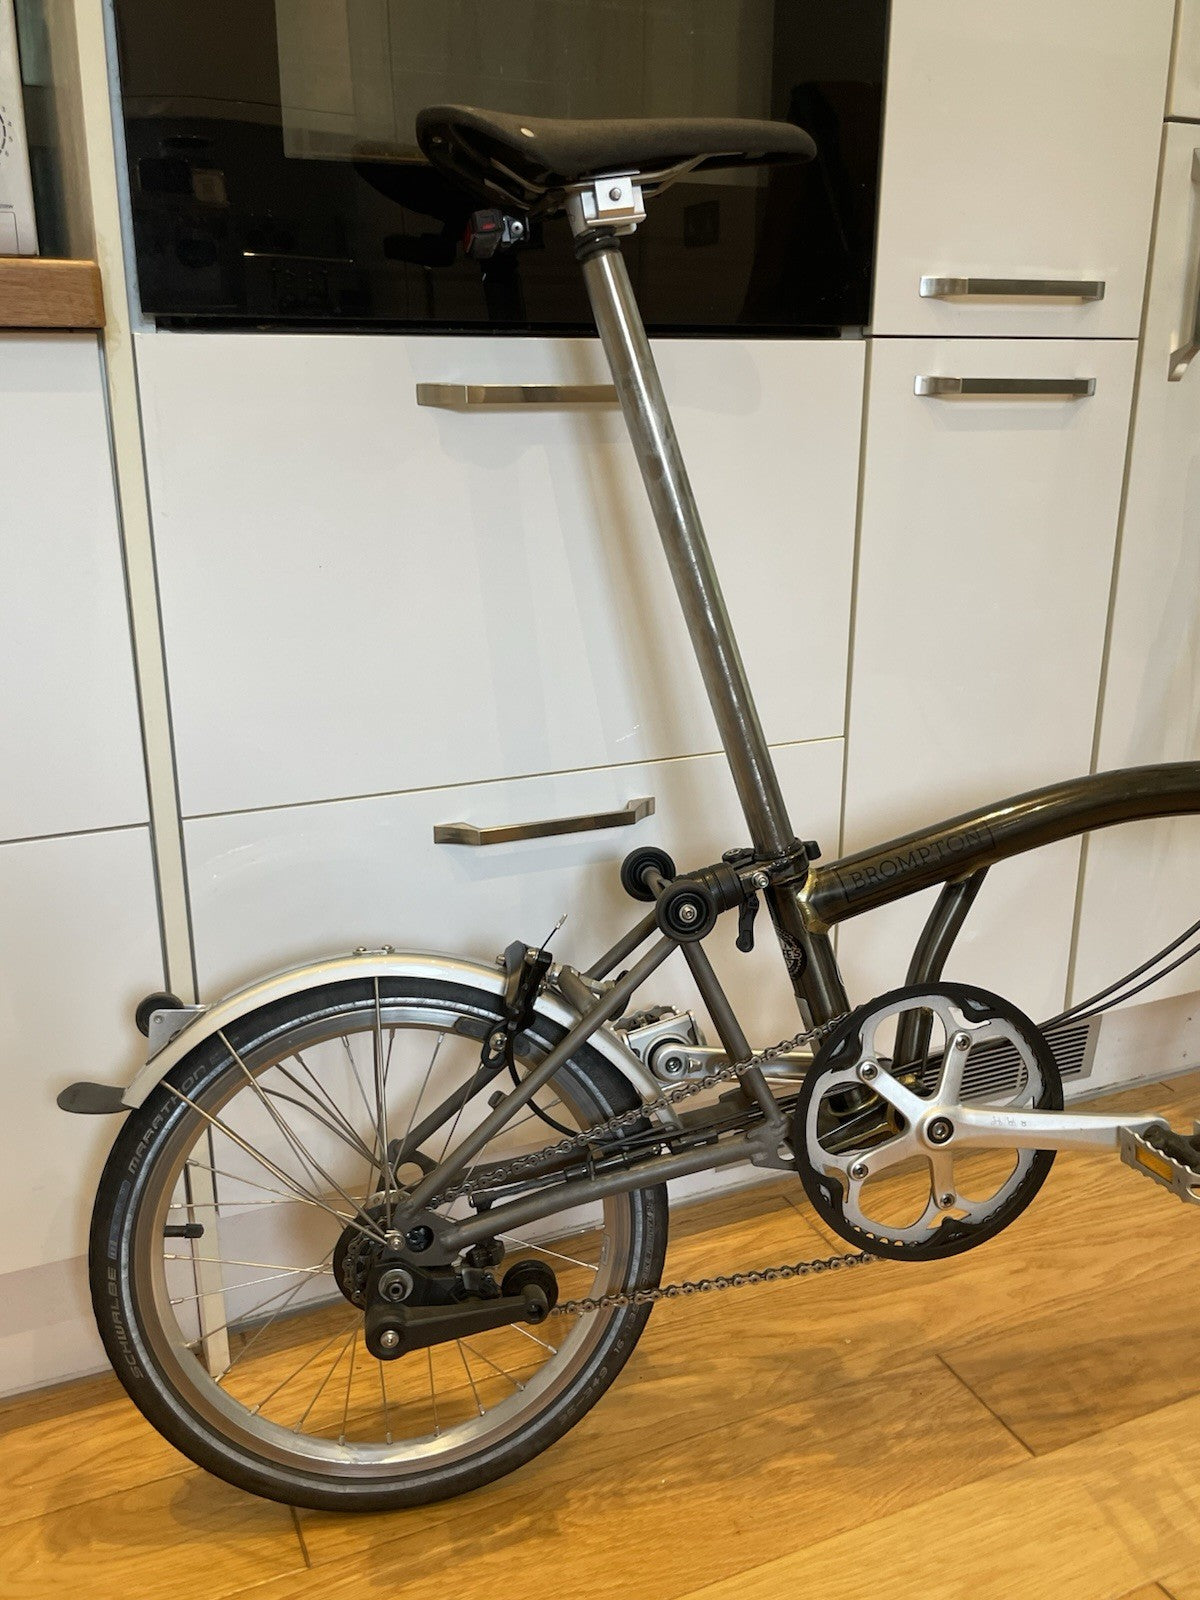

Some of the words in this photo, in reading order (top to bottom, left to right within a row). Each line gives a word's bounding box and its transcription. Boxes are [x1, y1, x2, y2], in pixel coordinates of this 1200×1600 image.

[849, 831, 985, 889] BROMPTON
[127, 1066, 207, 1175] MARATHON
[107, 1266, 145, 1380] SCHWALBE
